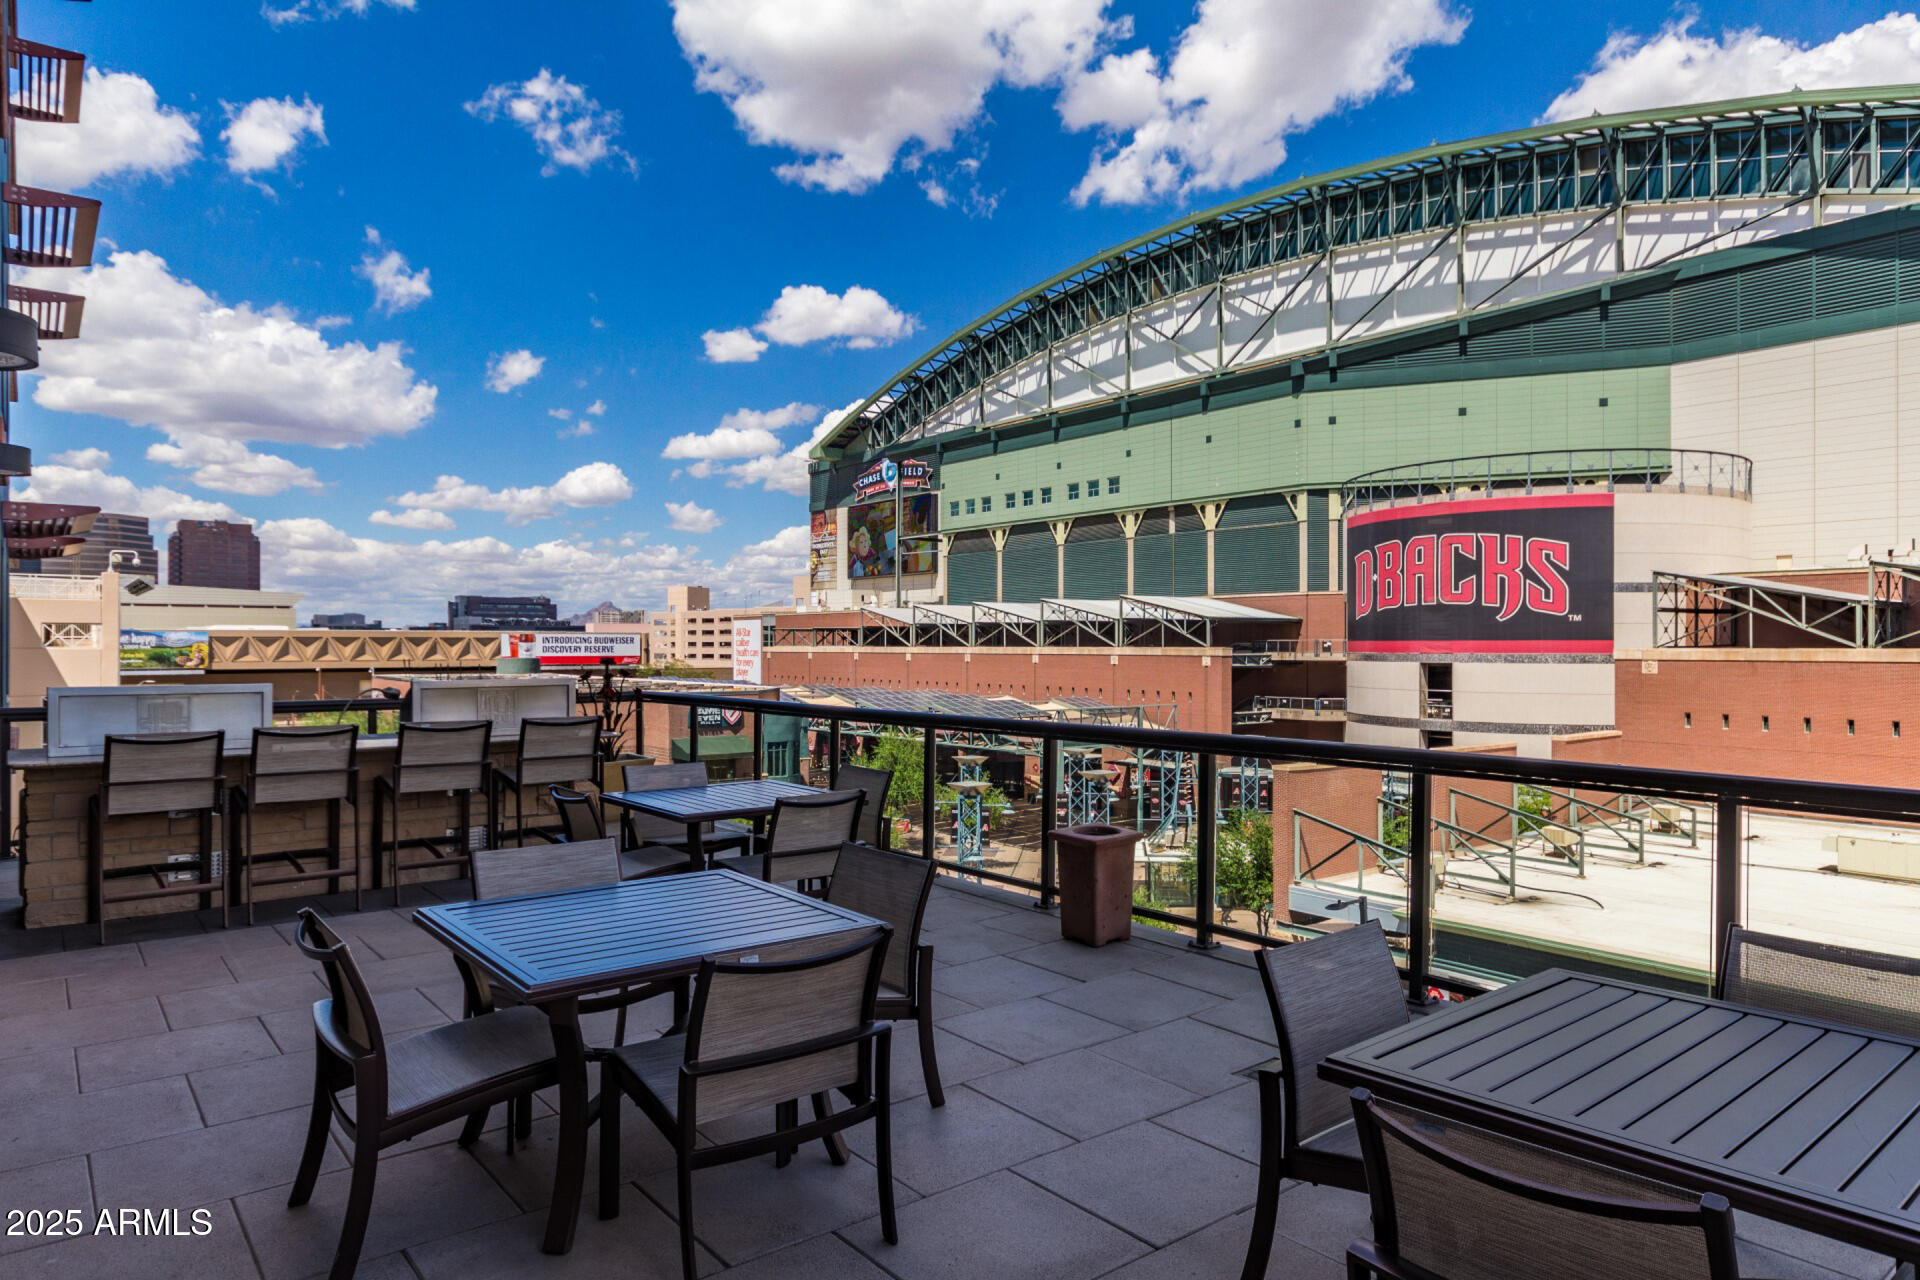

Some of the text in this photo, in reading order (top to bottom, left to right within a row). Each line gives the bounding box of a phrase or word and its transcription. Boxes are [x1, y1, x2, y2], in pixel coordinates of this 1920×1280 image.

[859, 472, 881, 487] CHASE
[542, 636, 635, 645] INTRODUCING BUDWEISER
[542, 645, 615, 654] DISCOVERY RESERVE
